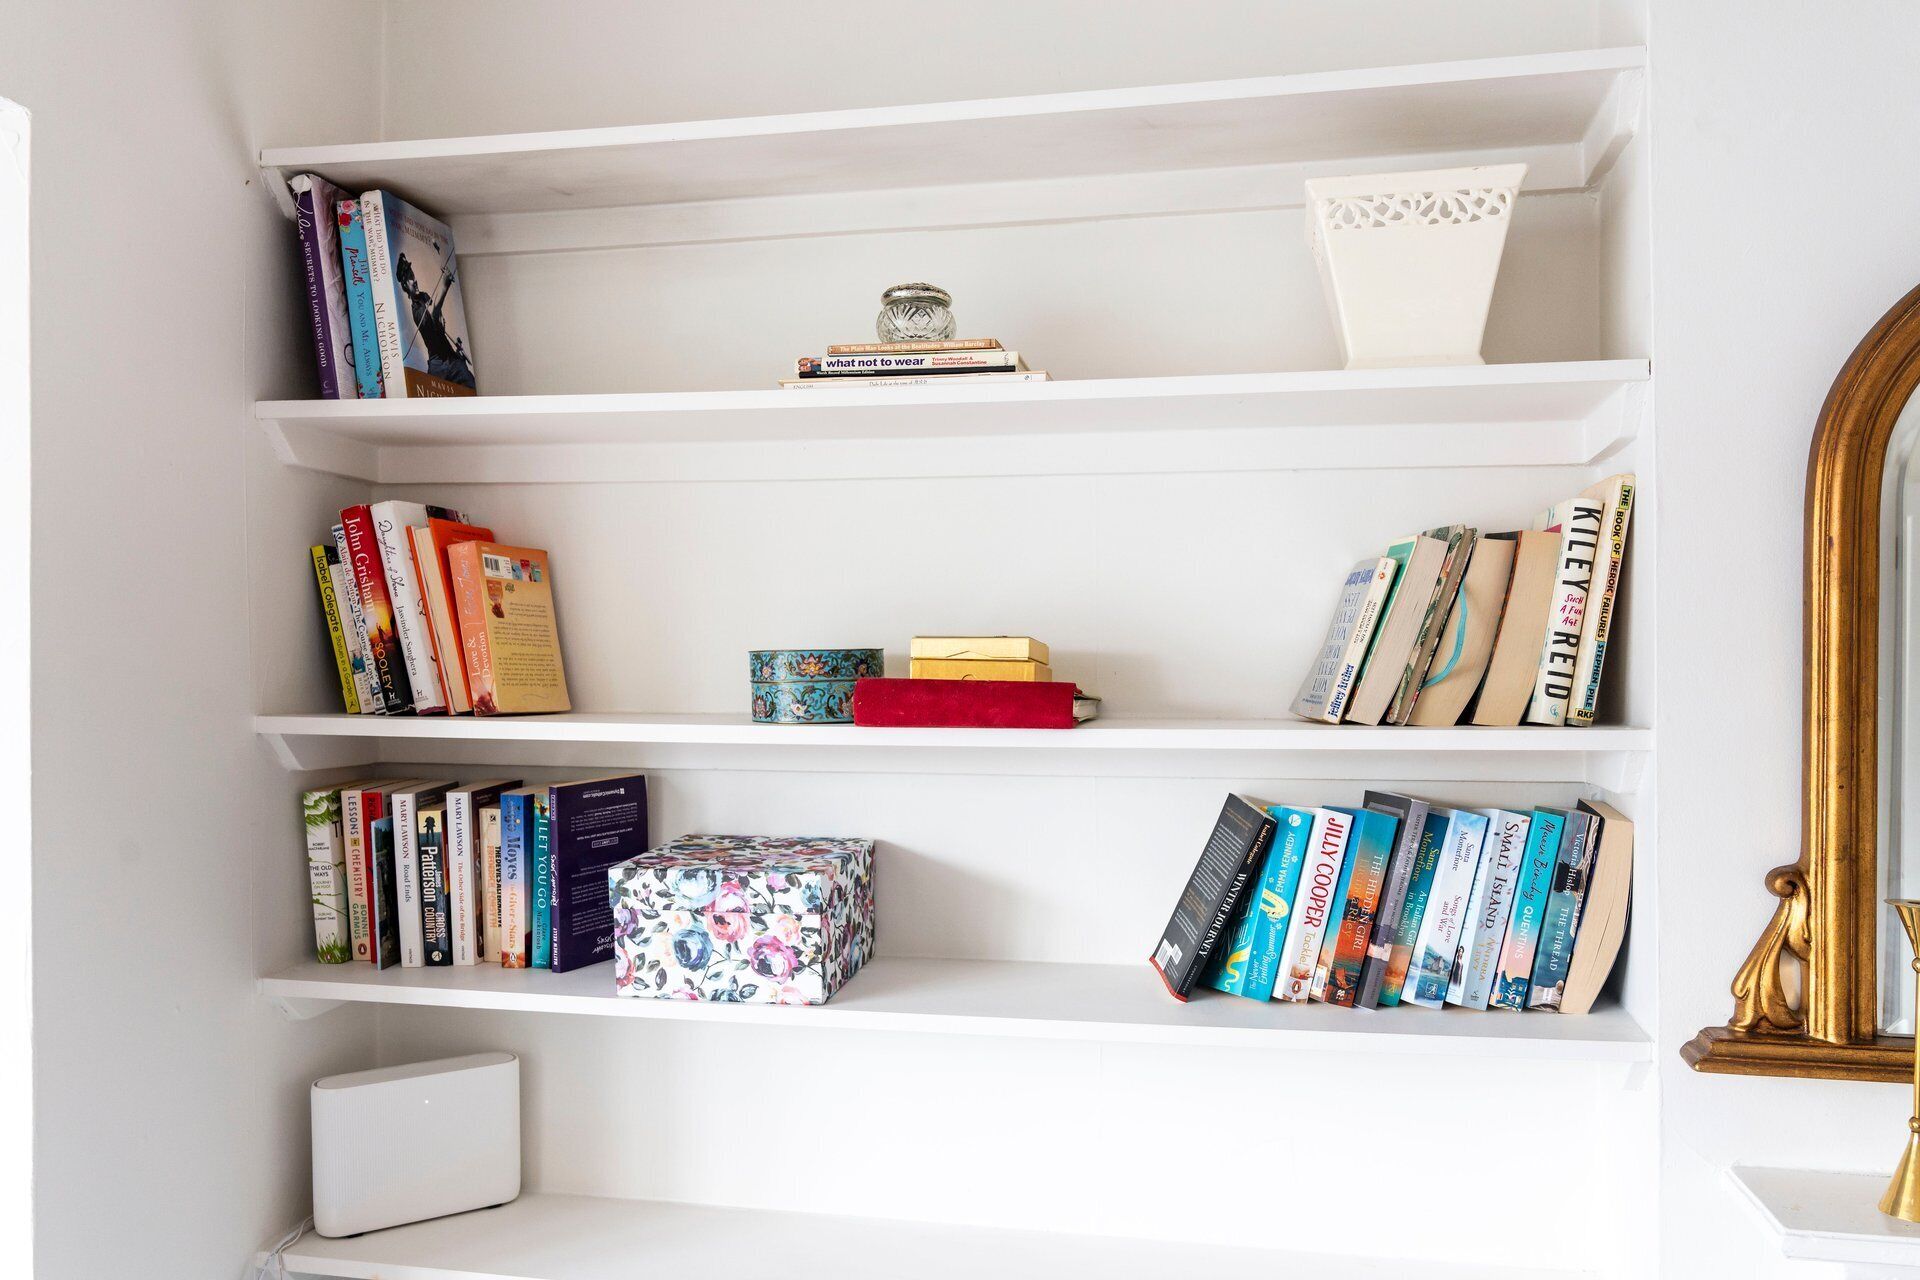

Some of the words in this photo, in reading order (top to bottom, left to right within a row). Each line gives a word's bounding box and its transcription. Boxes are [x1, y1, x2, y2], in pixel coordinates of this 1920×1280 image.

[304, 242, 316, 283] SECRETS
[345, 247, 365, 286] Mansell
[358, 258, 368, 274] Jill
[370, 249, 380, 282] MUMMY?
[377, 245, 385, 260] YOU
[380, 262, 387, 275] DO
[309, 284, 318, 297] TO
[312, 298, 324, 340] LOOKING
[375, 302, 392, 380] NICHOLSON
[388, 322, 400, 358] MAVIS
[878, 343, 894, 351] Looks
[901, 342, 911, 350] the
[964, 340, 986, 348] Barclay
[317, 342, 328, 368] GOOD
[826, 359, 856, 368] what
[858, 358, 878, 368] not
[880, 357, 893, 367] to
[895, 358, 925, 366] wear
[431, 380, 454, 394] MAVIS
[1620, 488, 1631, 507] THE
[345, 518, 363, 551] John
[1613, 510, 1624, 538] BOOK
[340, 546, 348, 566] Alain
[377, 520, 397, 564] Daughters
[1562, 506, 1602, 594] KILEY
[1613, 542, 1621, 556] OF
[316, 555, 331, 585] Isabel
[344, 568, 352, 577] de
[355, 553, 375, 613] Grisham
[1606, 560, 1619, 594] HEROIC
[347, 578, 357, 605] Botton
[323, 586, 340, 632] Colegate
[354, 607, 363, 625] The
[396, 605, 410, 640] Jasvinder
[1560, 605, 1567, 614] A
[1562, 616, 1578, 627] AGE
[1597, 597, 1611, 639] FAILURES
[358, 625, 368, 653] Course
[467, 637, 476, 648] &
[364, 653, 371, 662] of
[375, 642, 393, 690] SOOLEY
[405, 641, 417, 677] Sanghera
[471, 650, 481, 676] Love
[479, 631, 491, 679] Devotion
[1544, 631, 1580, 700] REID
[1591, 644, 1604, 687] STEPHEN
[344, 672, 353, 698] Garden
[366, 662, 374, 681] Love
[1327, 690, 1346, 717] Jeffrey
[1337, 663, 1355, 690] Archer
[1585, 688, 1595, 708] PILE
[1576, 709, 1594, 719] RKP
[582, 789, 620, 799] DynamicCatholic.com
[347, 796, 359, 835] LESSONS
[401, 825, 409, 859] LAWSON
[456, 822, 464, 857] LAWSON
[538, 827, 548, 851] LET
[1257, 824, 1271, 842] Isabel
[1320, 817, 1344, 862] JILLY
[1497, 821, 1520, 870] SMALL
[1539, 818, 1556, 857] Maeve
[504, 835, 521, 880] Moyes
[1246, 842, 1262, 865] Colegate
[1275, 867, 1286, 893] EMMA
[1281, 831, 1296, 868] KENNEDY
[1370, 854, 1384, 876] THE
[1412, 831, 1434, 882] Montefiore
[1425, 847, 1440, 871] Santa
[1452, 830, 1468, 872] Montefiore
[1464, 843, 1475, 863] Santa
[1569, 833, 1585, 868] Victoria
[352, 849, 363, 897] CHEMISTRY
[421, 846, 437, 902] Patterson
[537, 856, 547, 885] YOU
[1522, 858, 1549, 901] Binchy
[1563, 868, 1577, 896] Hislop
[509, 892, 517, 918] Giver
[537, 887, 547, 909] GO
[1220, 873, 1247, 912] WINTER
[1304, 863, 1334, 928] COOPER
[1359, 878, 1377, 924] HIDDEN
[1408, 891, 1416, 900] in
[1418, 890, 1427, 902] An
[1449, 895, 1462, 917] Songs
[1485, 876, 1508, 929] ISLAND
[352, 903, 361, 940] GARMUS
[360, 904, 368, 938] BONNIE
[1342, 908, 1359, 937] Riley
[1397, 902, 1413, 937] Brooklyn
[1410, 903, 1424, 928] Italian
[1441, 901, 1450, 916] and
[1559, 907, 1570, 928] THE
[424, 906, 437, 944] COUNTRY
[435, 912, 446, 938] CROSS
[509, 924, 517, 949] Stars
[1199, 912, 1226, 958] JOURNEY
[1352, 925, 1366, 951] GIRL
[1406, 930, 1417, 946] Girl
[1437, 916, 1448, 933] War
[1444, 925, 1456, 944] Love
[1514, 905, 1534, 959] QUENTINS
[1265, 924, 1277, 960] Summer
[1299, 932, 1317, 966] Tackle!
[1549, 930, 1565, 971] THREAD
[1249, 960, 1259, 982] Never
[1258, 954, 1271, 985] Ending
